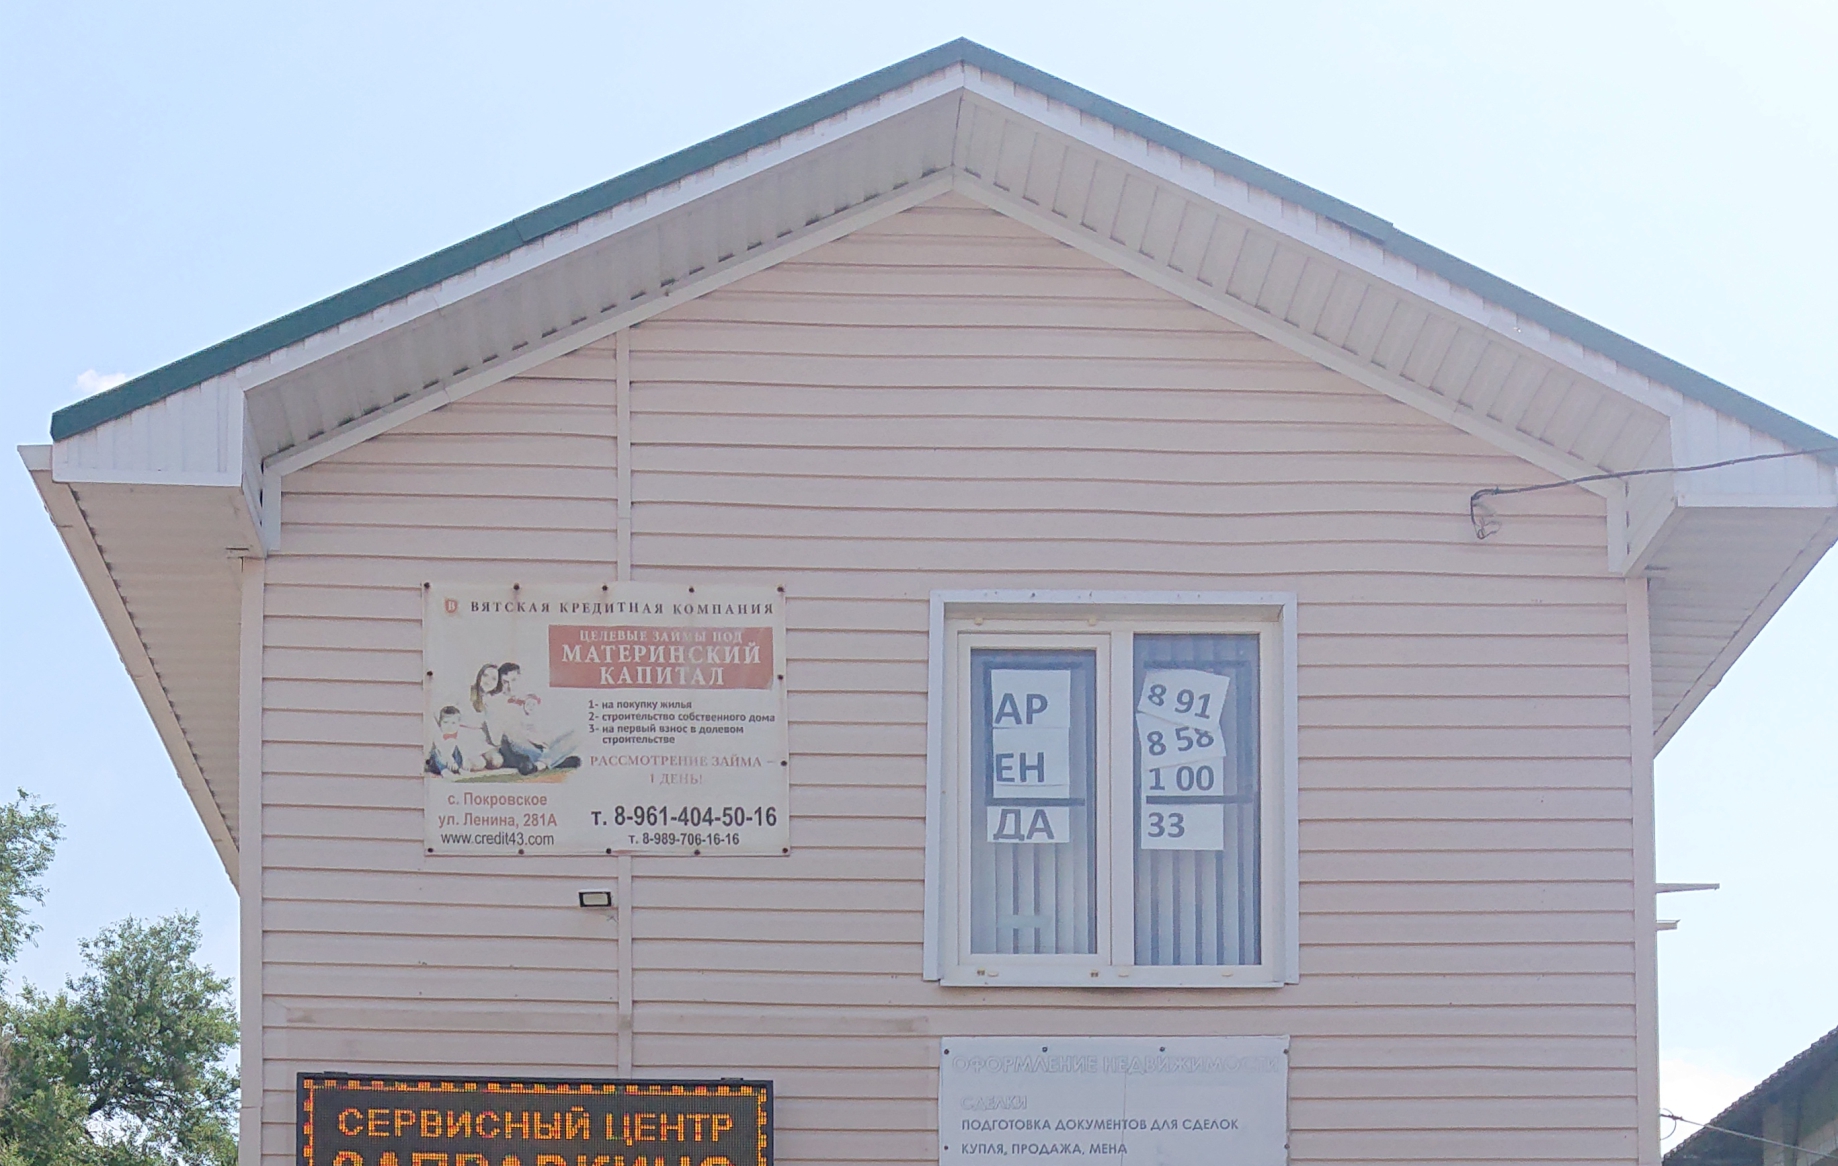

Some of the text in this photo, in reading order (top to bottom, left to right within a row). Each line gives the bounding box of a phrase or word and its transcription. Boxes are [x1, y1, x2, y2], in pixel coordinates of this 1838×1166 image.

[471, 601, 773, 615] ВЯТСКАЯ КРЕДИТНАЯ КОМПАНИЯ
[580, 630, 742, 643] ЦЕЛЕВЫЕ ЗАЙМЫ ПОД
[562, 642, 761, 664] МАТЕРИНСКИЙ
[600, 666, 724, 685] КАПИТАЛ
[617, 701, 657, 711] покупку
[994, 693, 1048, 724] АР
[1148, 684, 1212, 719] 8 91
[589, 713, 599, 721] 2-
[602, 714, 675, 723] строительство
[678, 712, 746, 722] собственного
[589, 724, 599, 733] 3-
[618, 724, 656, 735] первый
[699, 726, 744, 734] долевом
[602, 736, 675, 745] строительстве
[1147, 731, 1166, 756] 8
[590, 755, 708, 767] РАССМОТРЕНИЕ
[712, 754, 761, 767] ЗАЙМА
[996, 752, 1045, 783] ЕН
[660, 773, 702, 785] ДЕНЬ!
[1149, 766, 1214, 790] 1 00
[448, 792, 547, 808] с. Покровское
[438, 813, 557, 829] ул. Ленина, 281А
[591, 806, 776, 827] т. 8-961-404-50-16
[992, 808, 1054, 841] ДА
[1148, 812, 1185, 838] 33
[441, 832, 554, 846] www.credit43.com
[629, 833, 739, 845] т. 8-989-706-16-16
[952, 1055, 1097, 1073] ОФОРМЛЕНИЕ
[960, 1096, 1027, 1111] СДЕЛКИ
[339, 1106, 733, 1145] СЕРВИСНЫЙ ЦЕНТР
[962, 1119, 1238, 1132] ПОДГОТОВКА ДОКУМЕНТОВ ДЛЯ СДЕЛОК
[962, 1144, 1127, 1156] КУПЛЯ, ПРОДАЖА, МЕНА
